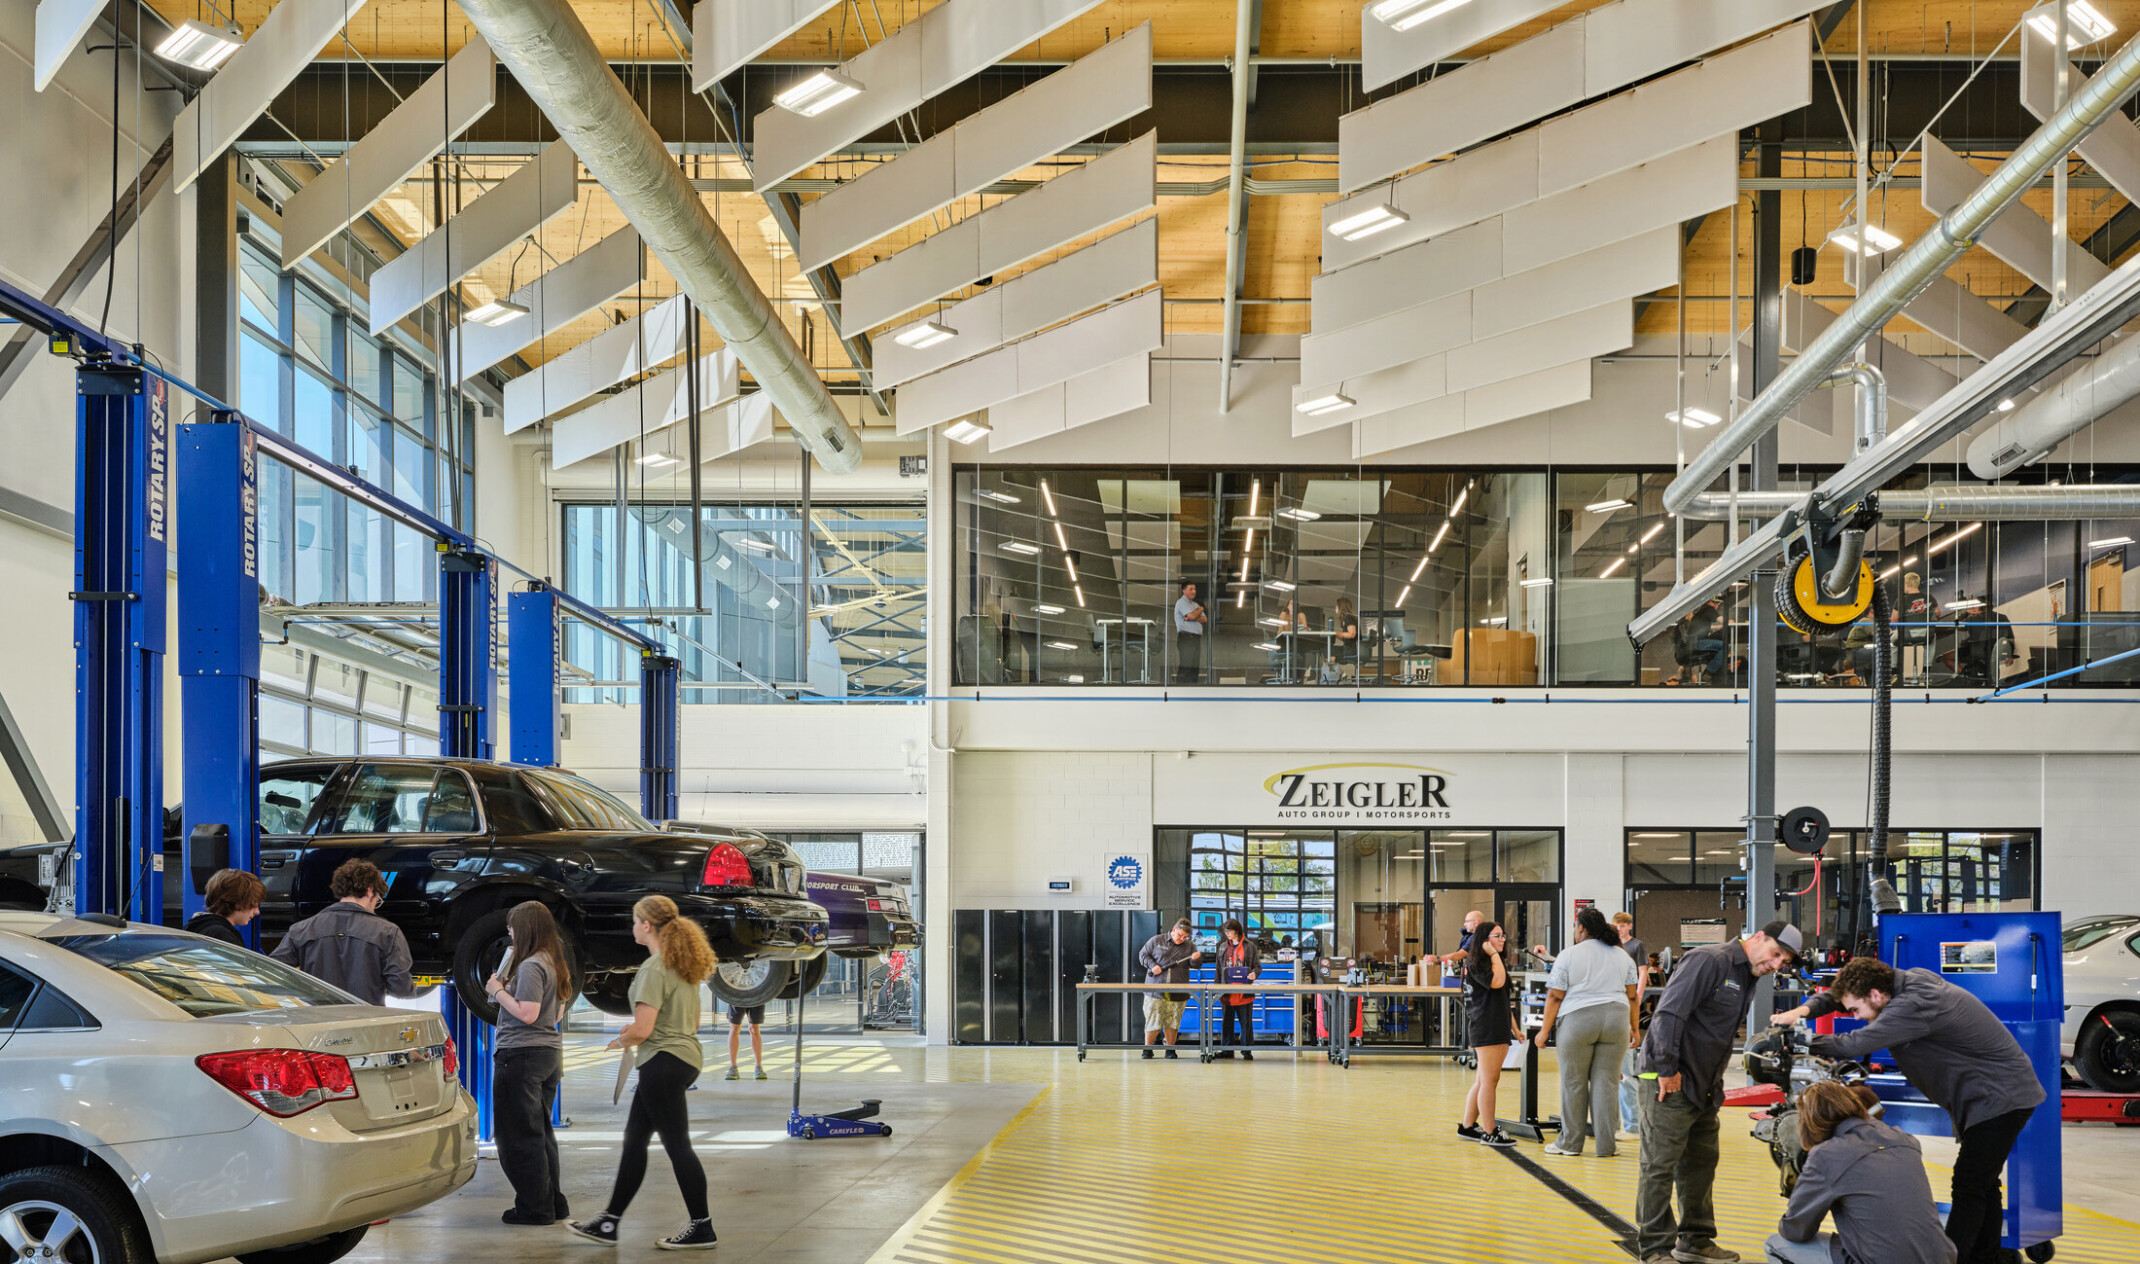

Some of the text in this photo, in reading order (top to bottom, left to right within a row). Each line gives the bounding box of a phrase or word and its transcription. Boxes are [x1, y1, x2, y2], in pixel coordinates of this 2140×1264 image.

[152, 394, 166, 437] SP
[243, 444, 256, 480] SP
[150, 433, 164, 542] ROTARY
[244, 475, 256, 578] ROTARY
[489, 598, 497, 671] ROTARY
[1278, 774, 1450, 808] ZEIGLER
[806, 882, 839, 891] ORSPORT
[1112, 866, 1137, 877] ASE
